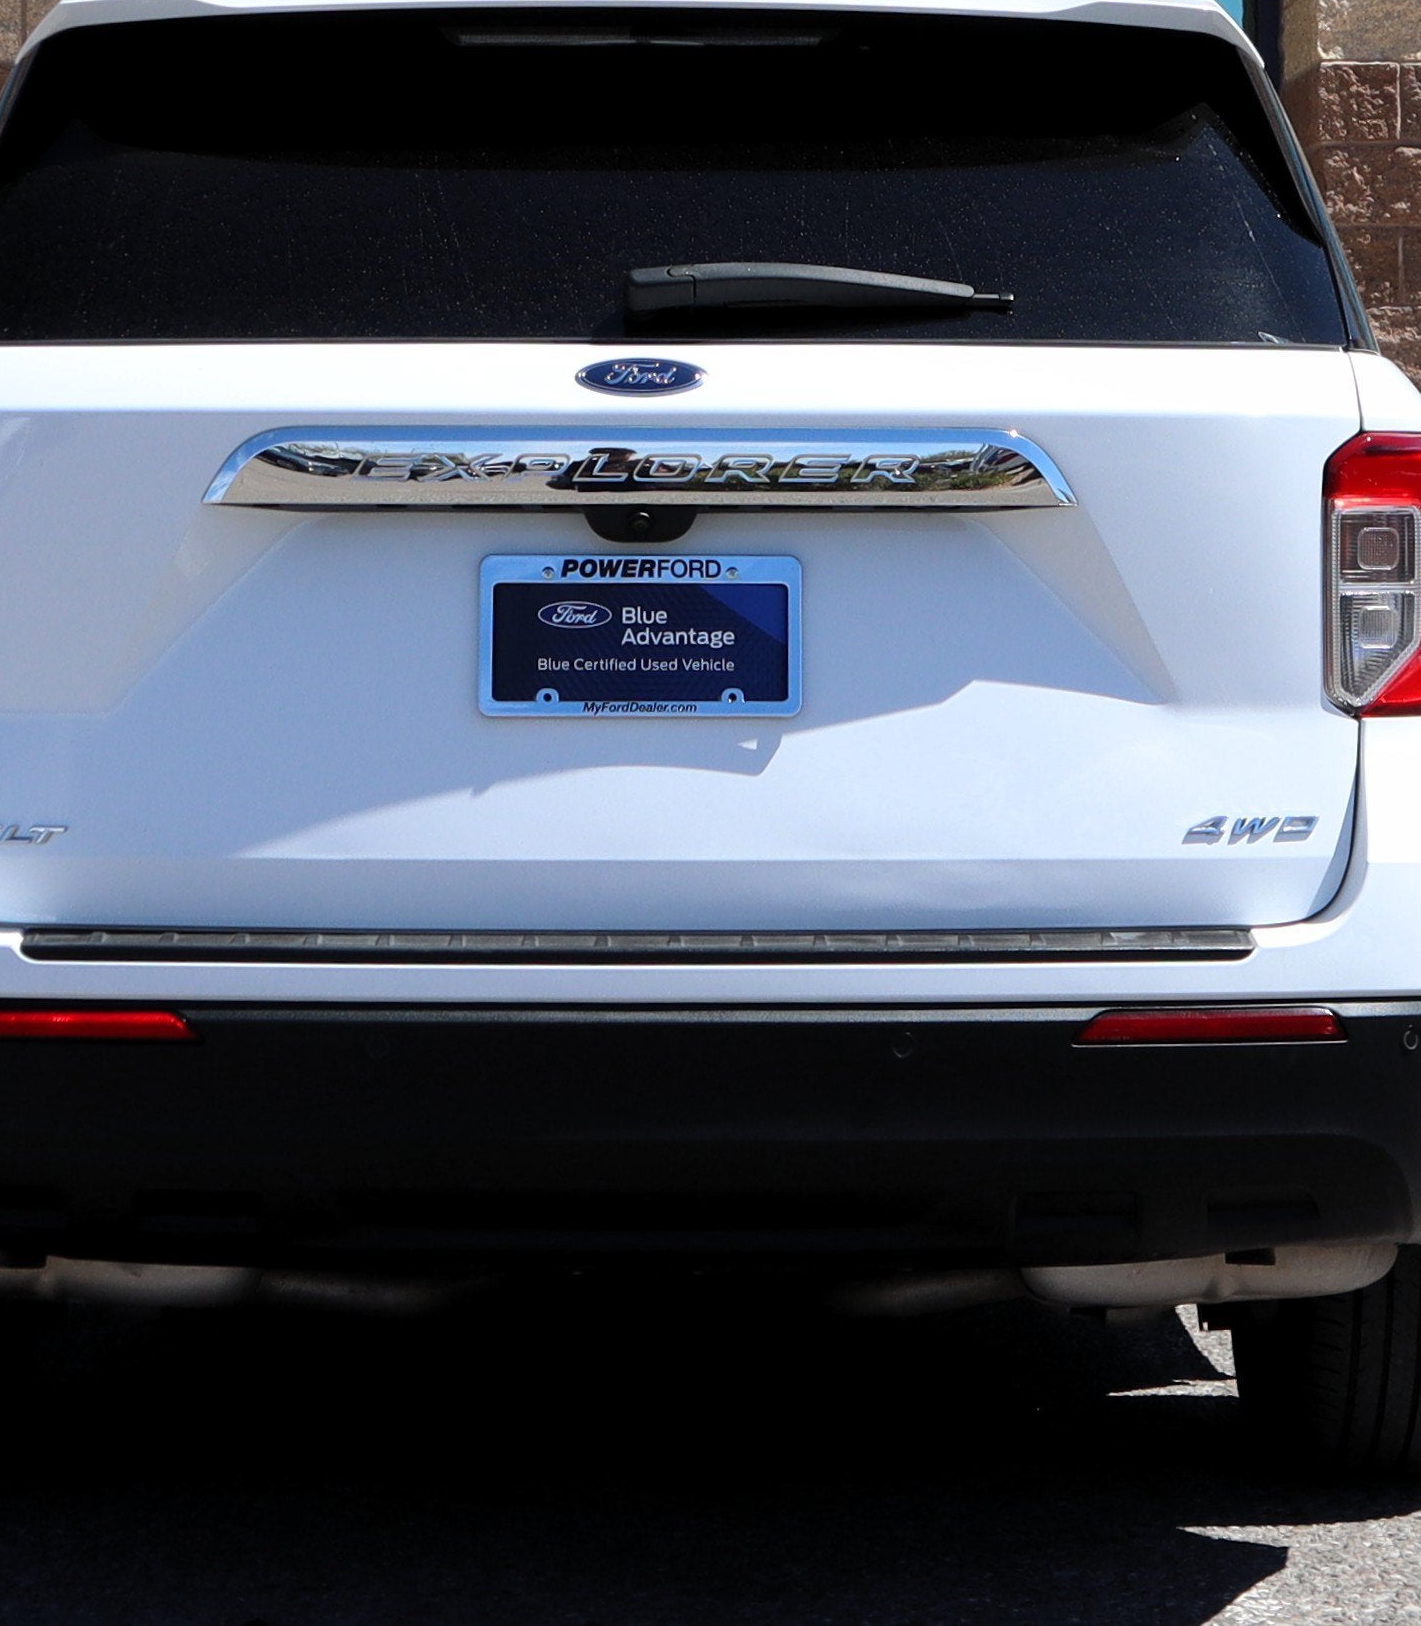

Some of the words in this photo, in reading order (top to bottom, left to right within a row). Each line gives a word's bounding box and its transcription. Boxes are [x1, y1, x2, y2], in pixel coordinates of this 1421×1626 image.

[603, 362, 677, 385] Ford
[352, 453, 922, 483] EXPLORER
[561, 558, 722, 579] POWERFORD
[551, 604, 598, 625] Ford
[621, 606, 668, 625] Blue
[621, 627, 735, 649] Advantage
[537, 658, 570, 672] Blue
[573, 658, 636, 672] Certified
[640, 658, 678, 672] Used
[681, 658, 735, 672] Vehicle
[583, 701, 698, 716] MyFordDealer.com
[1186, 815, 1320, 840] 4WD
